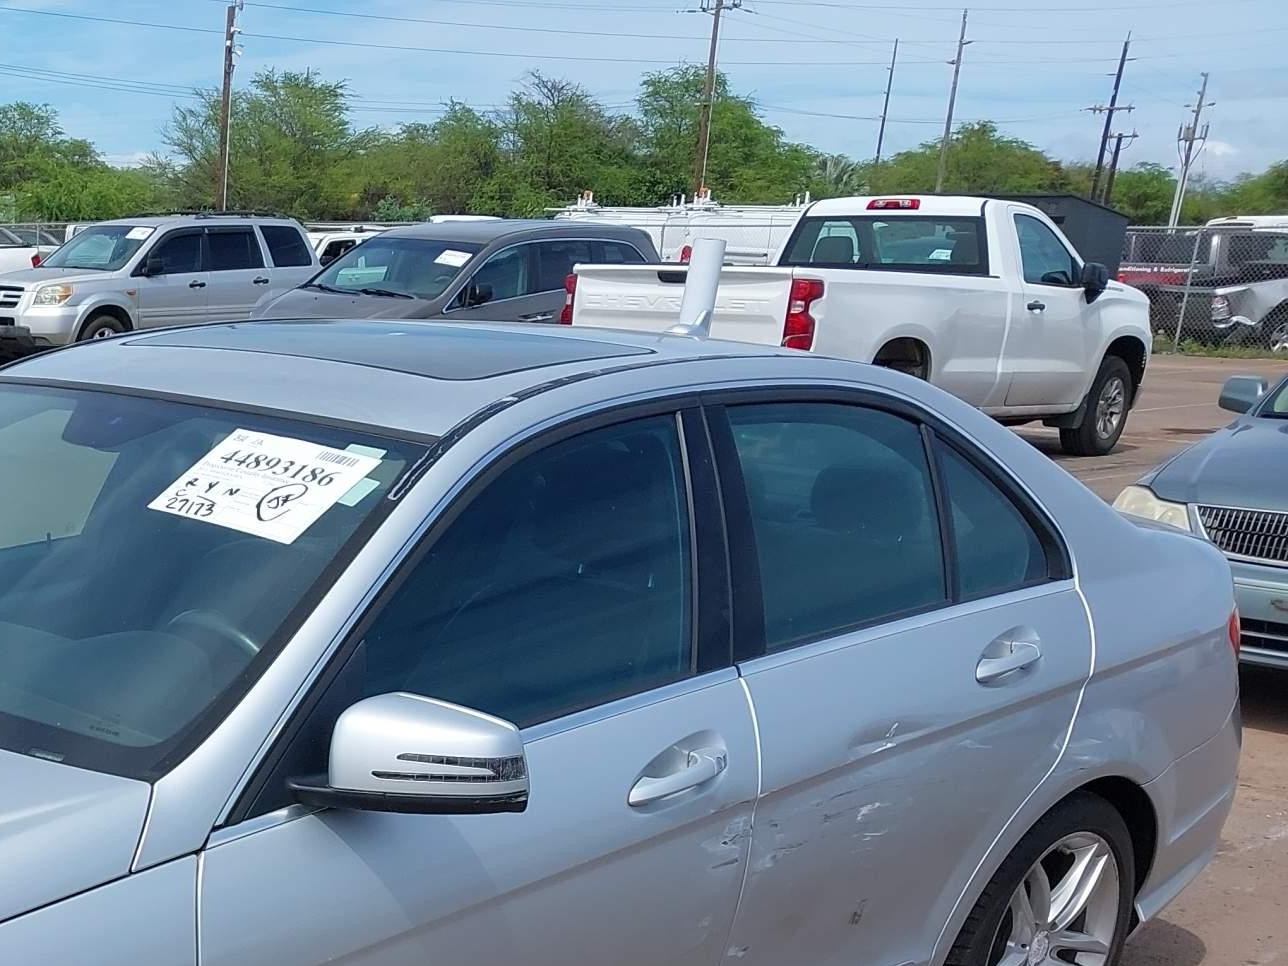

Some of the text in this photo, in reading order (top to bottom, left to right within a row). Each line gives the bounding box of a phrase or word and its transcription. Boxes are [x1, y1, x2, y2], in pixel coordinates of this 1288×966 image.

[1160, 266, 1199, 274] Refrigeraton
[584, 293, 771, 312] CHEVRET
[220, 450, 342, 487] 44893186
